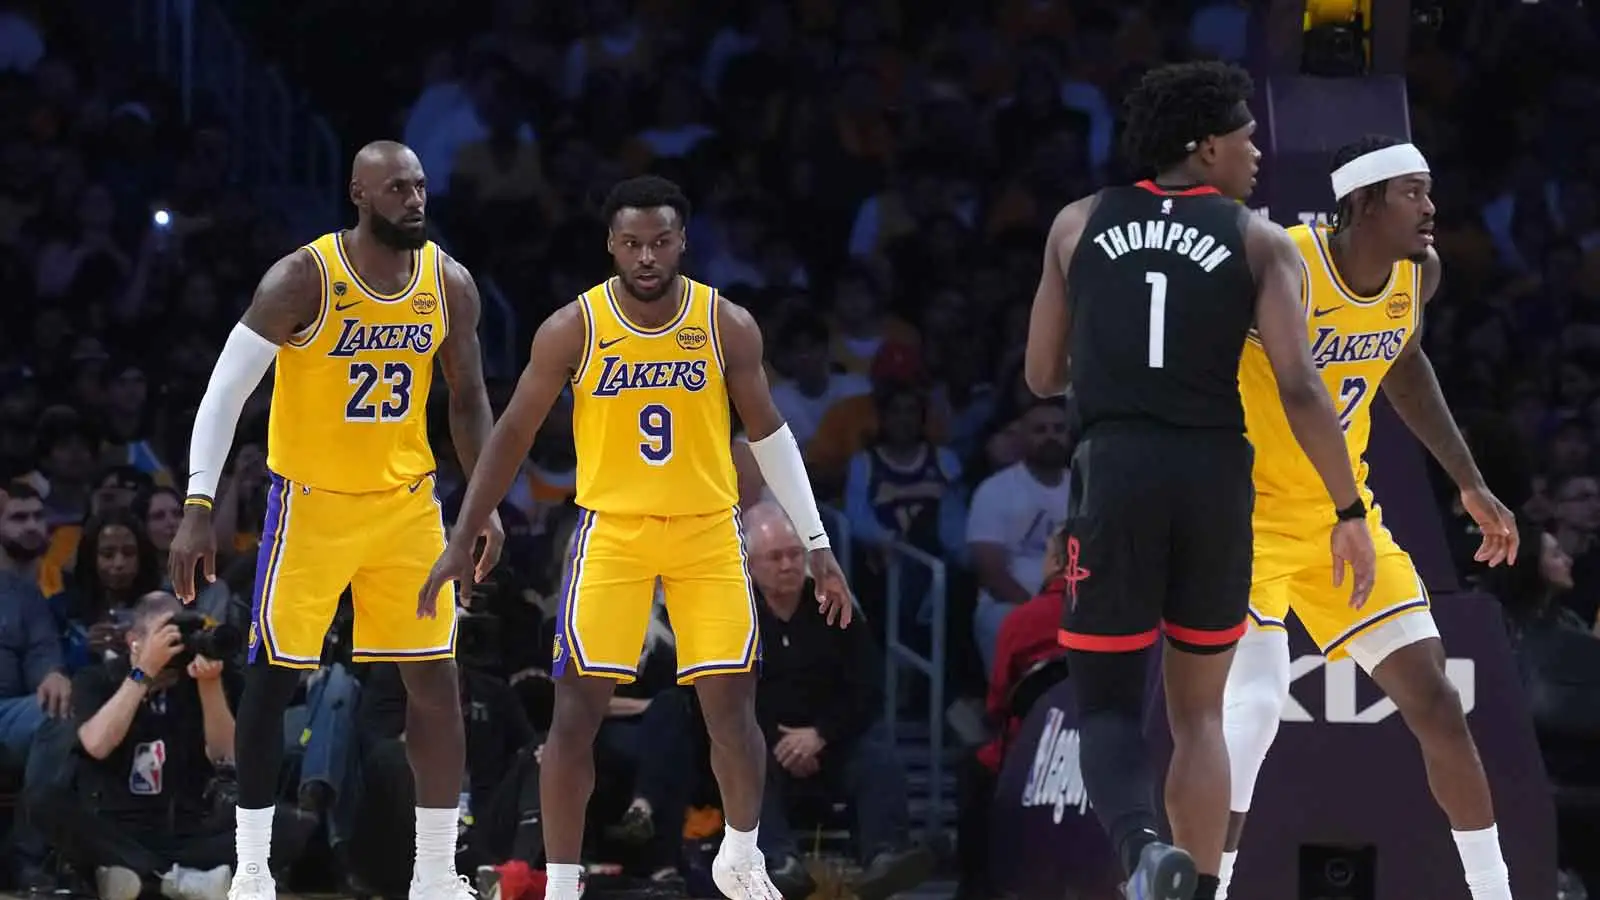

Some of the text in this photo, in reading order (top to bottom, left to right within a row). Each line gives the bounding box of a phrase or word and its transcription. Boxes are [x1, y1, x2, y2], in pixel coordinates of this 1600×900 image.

[1093, 220, 1232, 273] THOMPSON
[327, 318, 434, 358] LAKERS
[679, 332, 706, 343] bibigo
[1145, 271, 1168, 368] 1
[1311, 327, 1406, 369] LAKERS
[344, 361, 413, 422] 23
[591, 356, 707, 397] LAKERS
[1338, 375, 1369, 431] 2
[638, 403, 674, 465] 9
